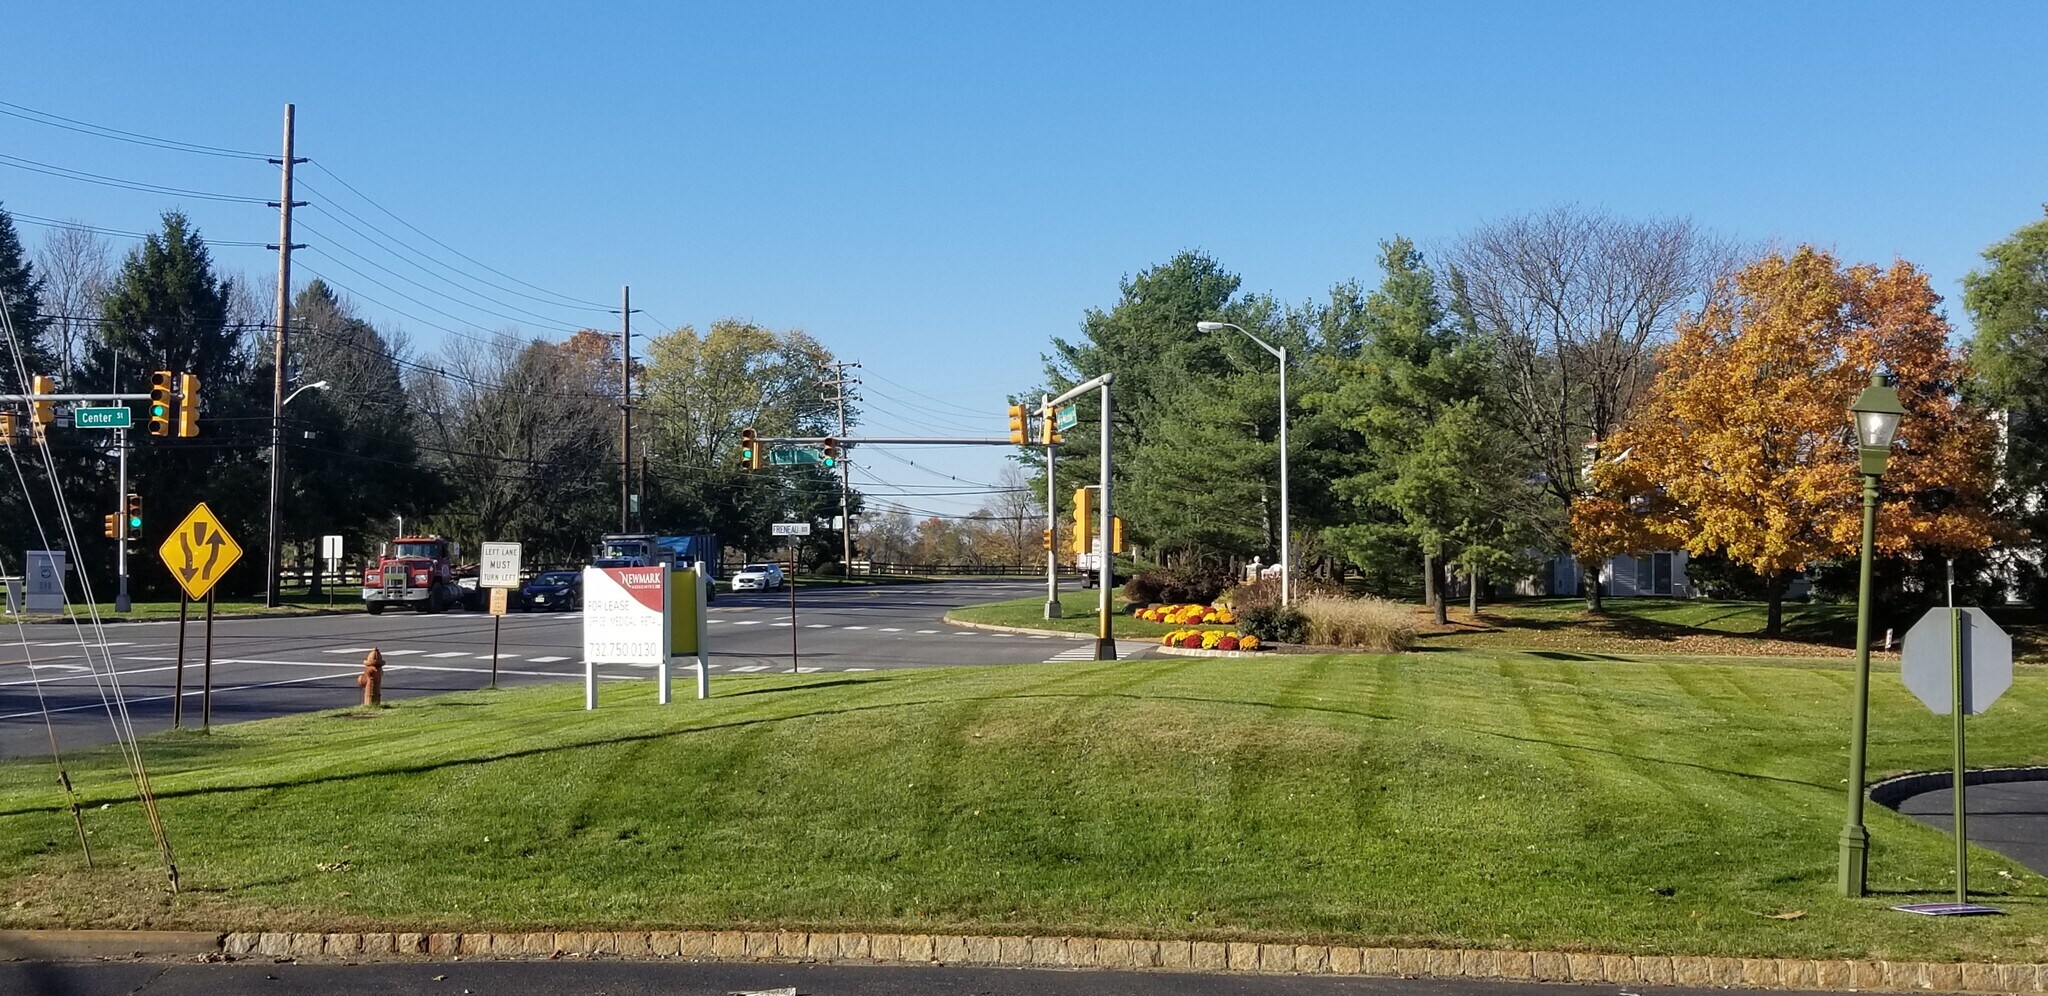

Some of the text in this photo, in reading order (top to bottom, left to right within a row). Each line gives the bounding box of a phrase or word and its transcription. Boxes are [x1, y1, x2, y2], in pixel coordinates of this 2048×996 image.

[82, 411, 124, 423] Center St
[773, 525, 799, 534] FRENEAU
[485, 548, 517, 556] LEFT LANE
[490, 560, 511, 569] MUST
[484, 573, 500, 581] TURN
[619, 571, 661, 586] NEWMARK
[588, 600, 630, 611] FOR LEASE
[588, 642, 657, 657] 732.750.0130
